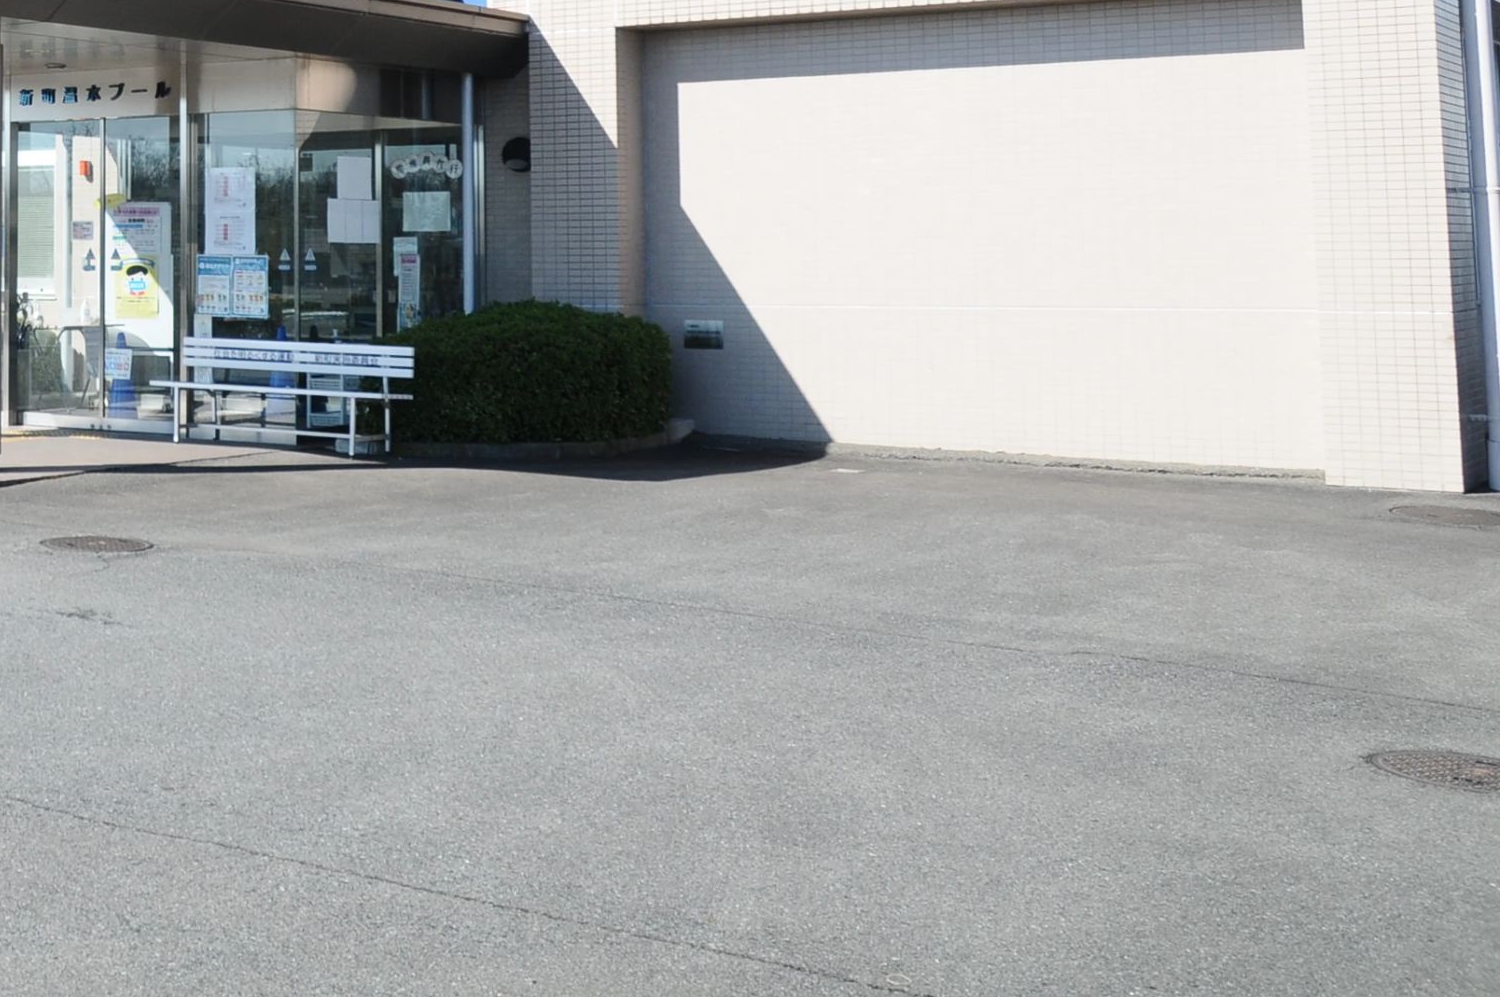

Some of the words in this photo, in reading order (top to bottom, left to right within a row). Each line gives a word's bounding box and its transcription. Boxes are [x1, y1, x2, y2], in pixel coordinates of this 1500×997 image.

[19, 81, 172, 106] 新町温水プール
